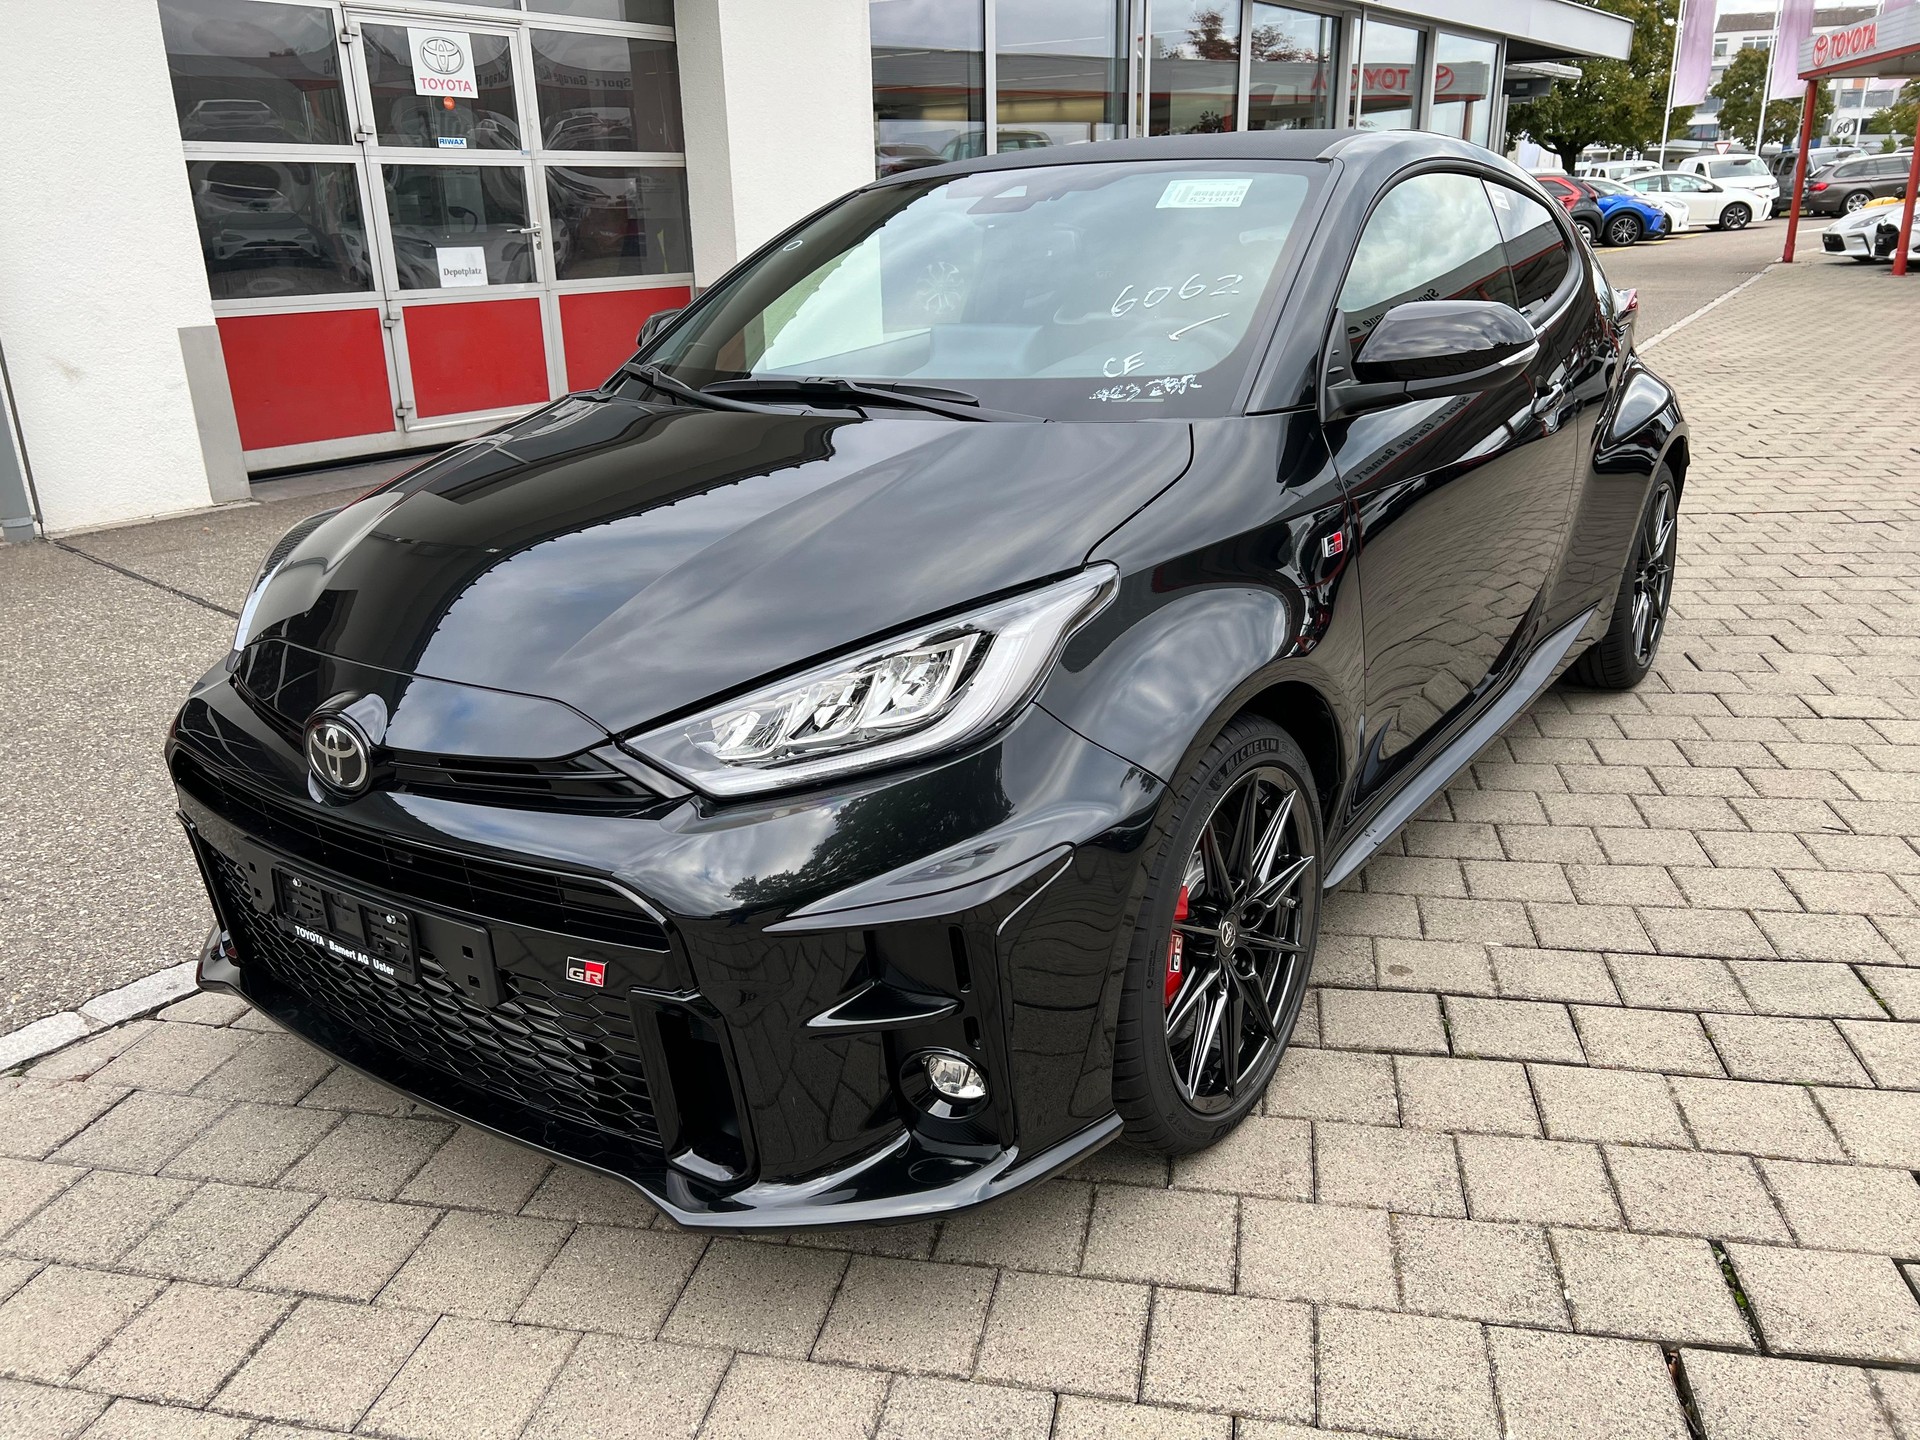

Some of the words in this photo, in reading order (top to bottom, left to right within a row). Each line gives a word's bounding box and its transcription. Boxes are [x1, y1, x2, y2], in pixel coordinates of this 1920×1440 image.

[1831, 23, 1877, 60] TOYOTA
[419, 78, 473, 92] TOYOTA
[1836, 122, 1850, 134] 60
[439, 138, 465, 146] RIWAX
[443, 267, 483, 278] Depotplatz
[1110, 273, 1243, 318] 6062
[1102, 351, 1145, 378] CE
[1224, 738, 1279, 774] MICHELIN
[294, 925, 325, 947] TOYOTA
[328, 940, 357, 961] Bamert
[357, 952, 370, 966] AG
[372, 958, 395, 976] Uster
[568, 967, 603, 985] GR
